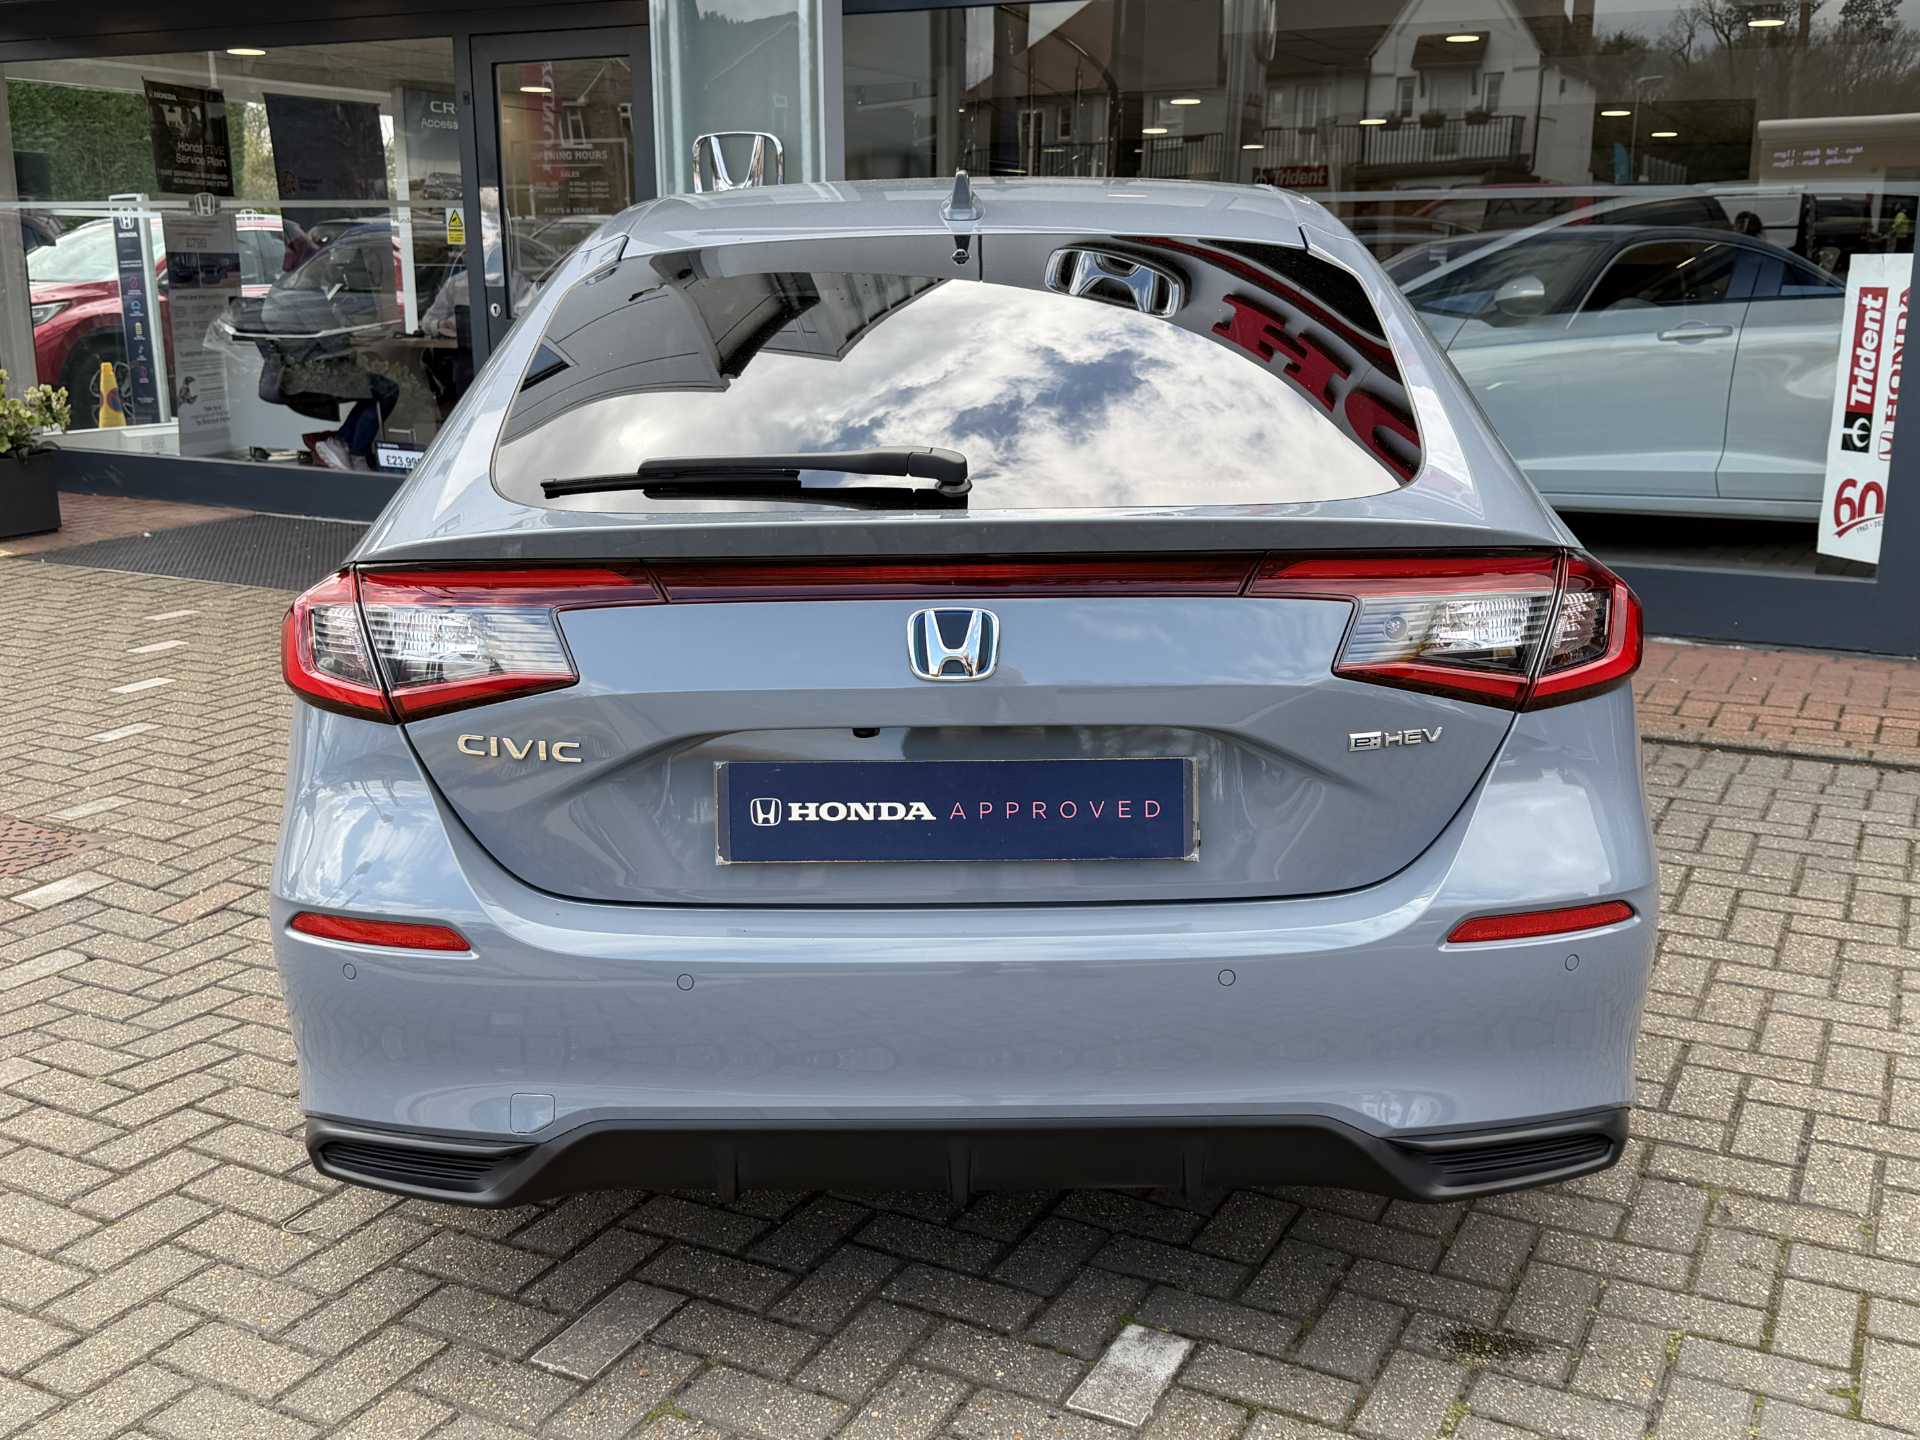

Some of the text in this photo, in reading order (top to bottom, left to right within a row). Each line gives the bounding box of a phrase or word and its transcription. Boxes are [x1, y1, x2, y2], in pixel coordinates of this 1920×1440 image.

[207, 156, 227, 168] Plan
[575, 150, 608, 160] HOURS
[457, 734, 583, 763] CIVIC
[787, 800, 1162, 822] HONDA APPROVED
